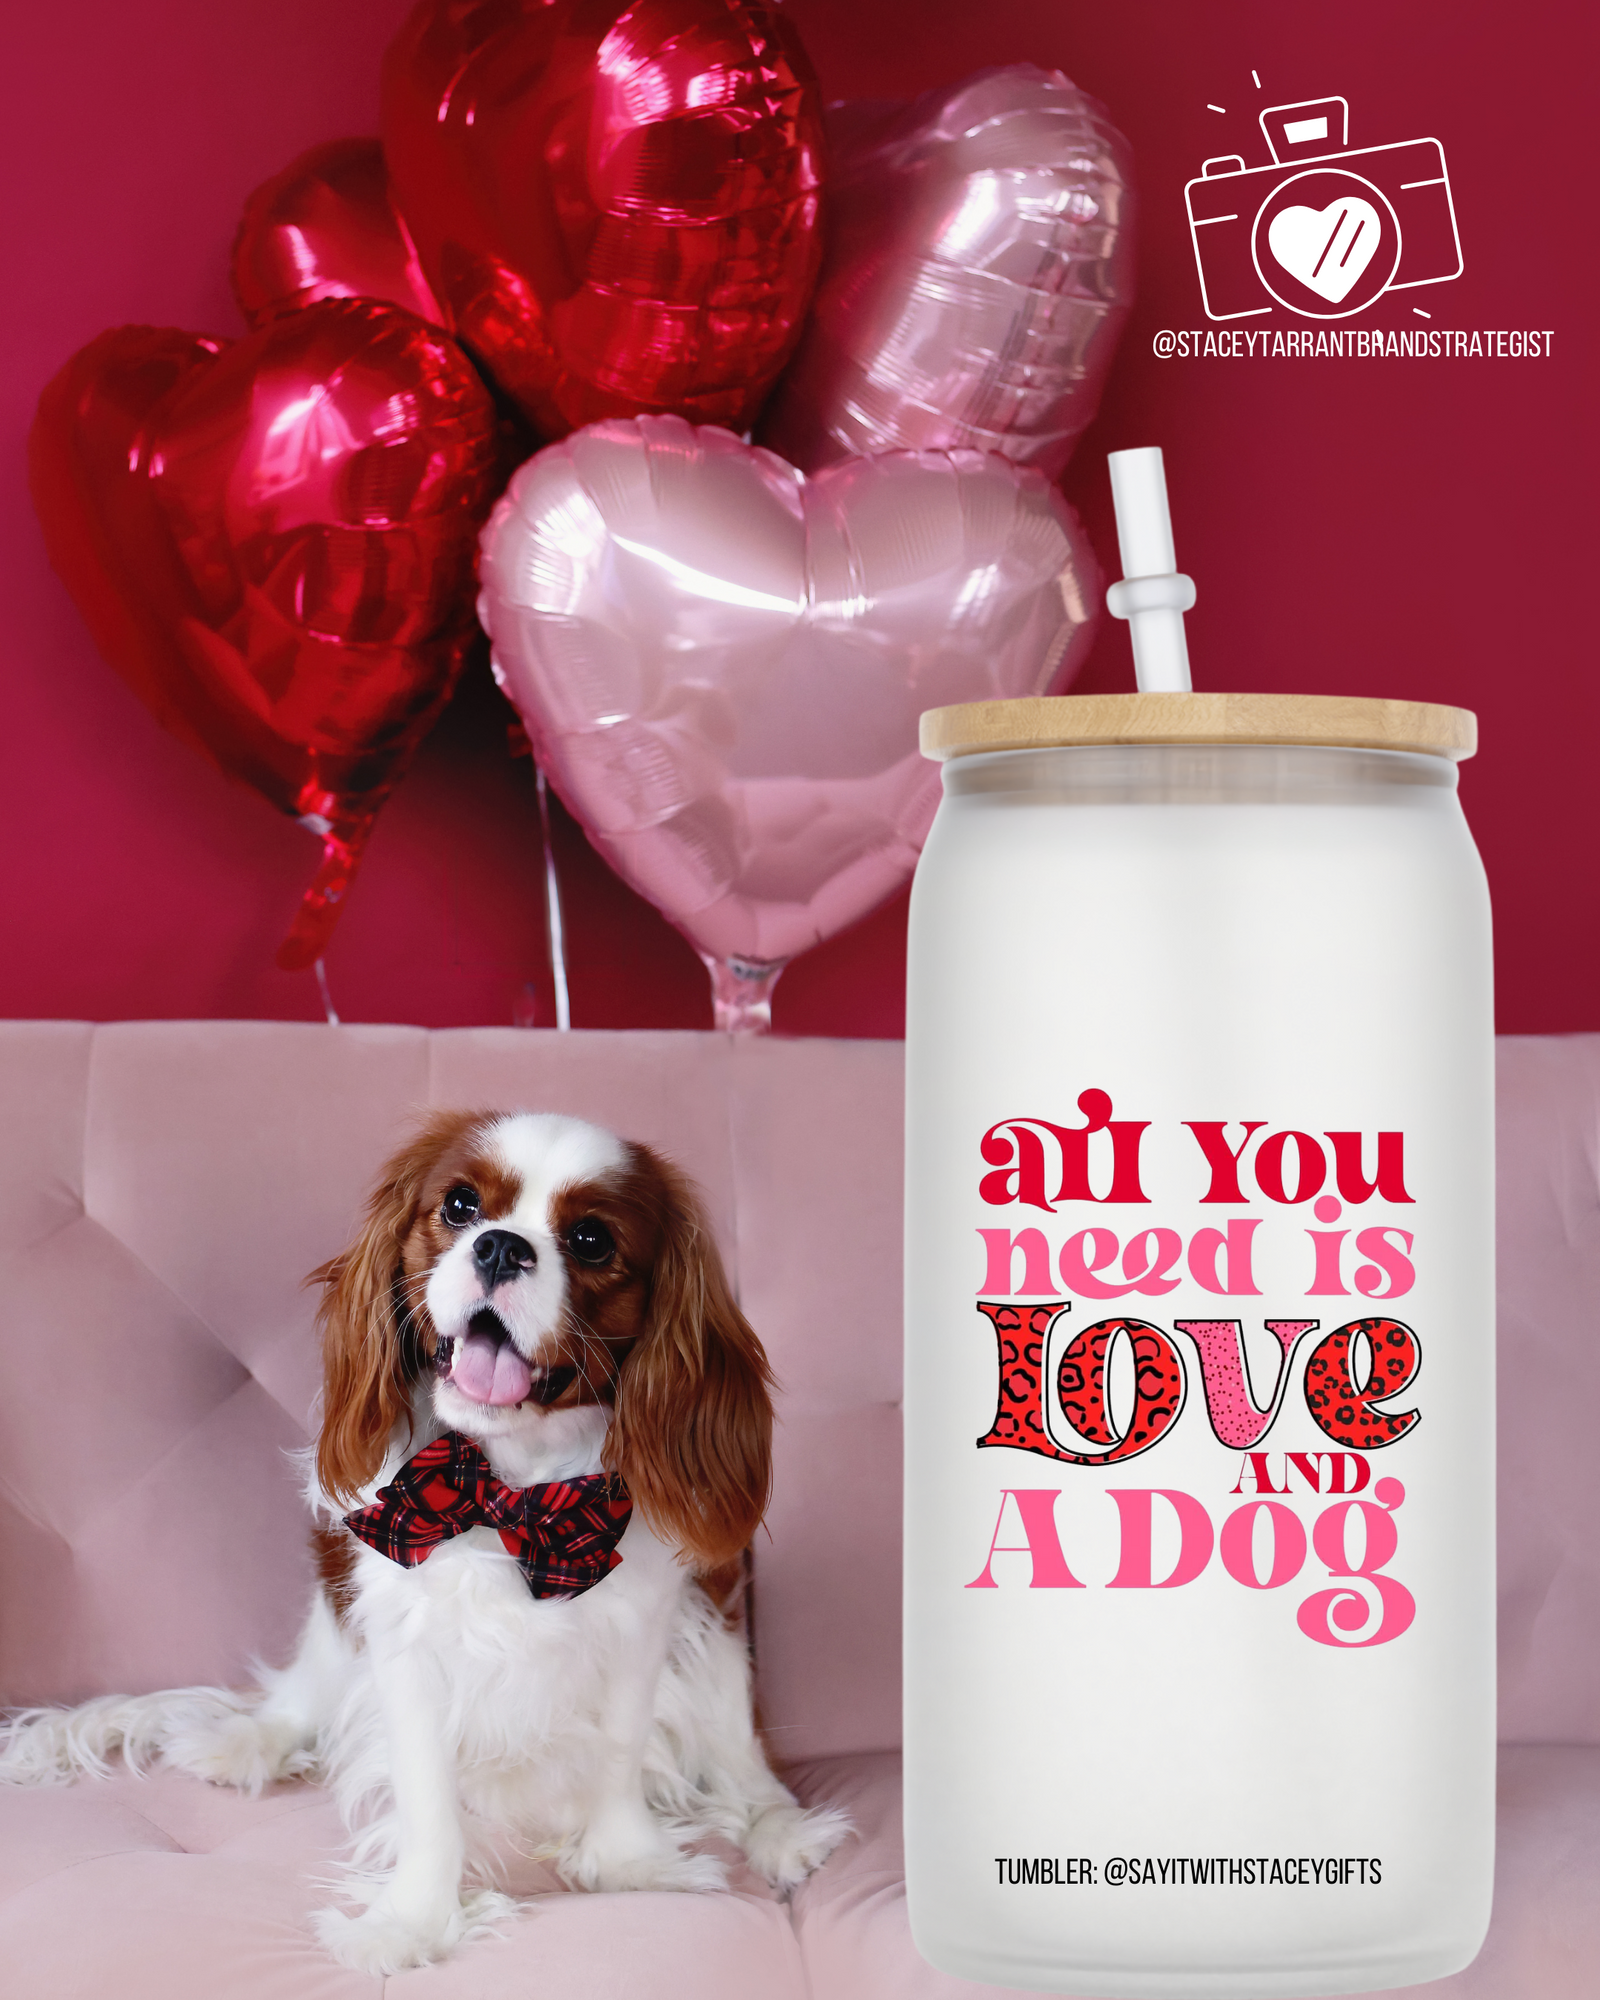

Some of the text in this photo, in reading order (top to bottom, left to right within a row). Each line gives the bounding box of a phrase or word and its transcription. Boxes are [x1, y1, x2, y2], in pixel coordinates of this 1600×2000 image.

[1181, 1121, 1416, 1204] You
[975, 1195, 1416, 1300] need is
[1228, 1452, 1372, 1494] AND
[964, 1476, 1417, 1648] A Dog
